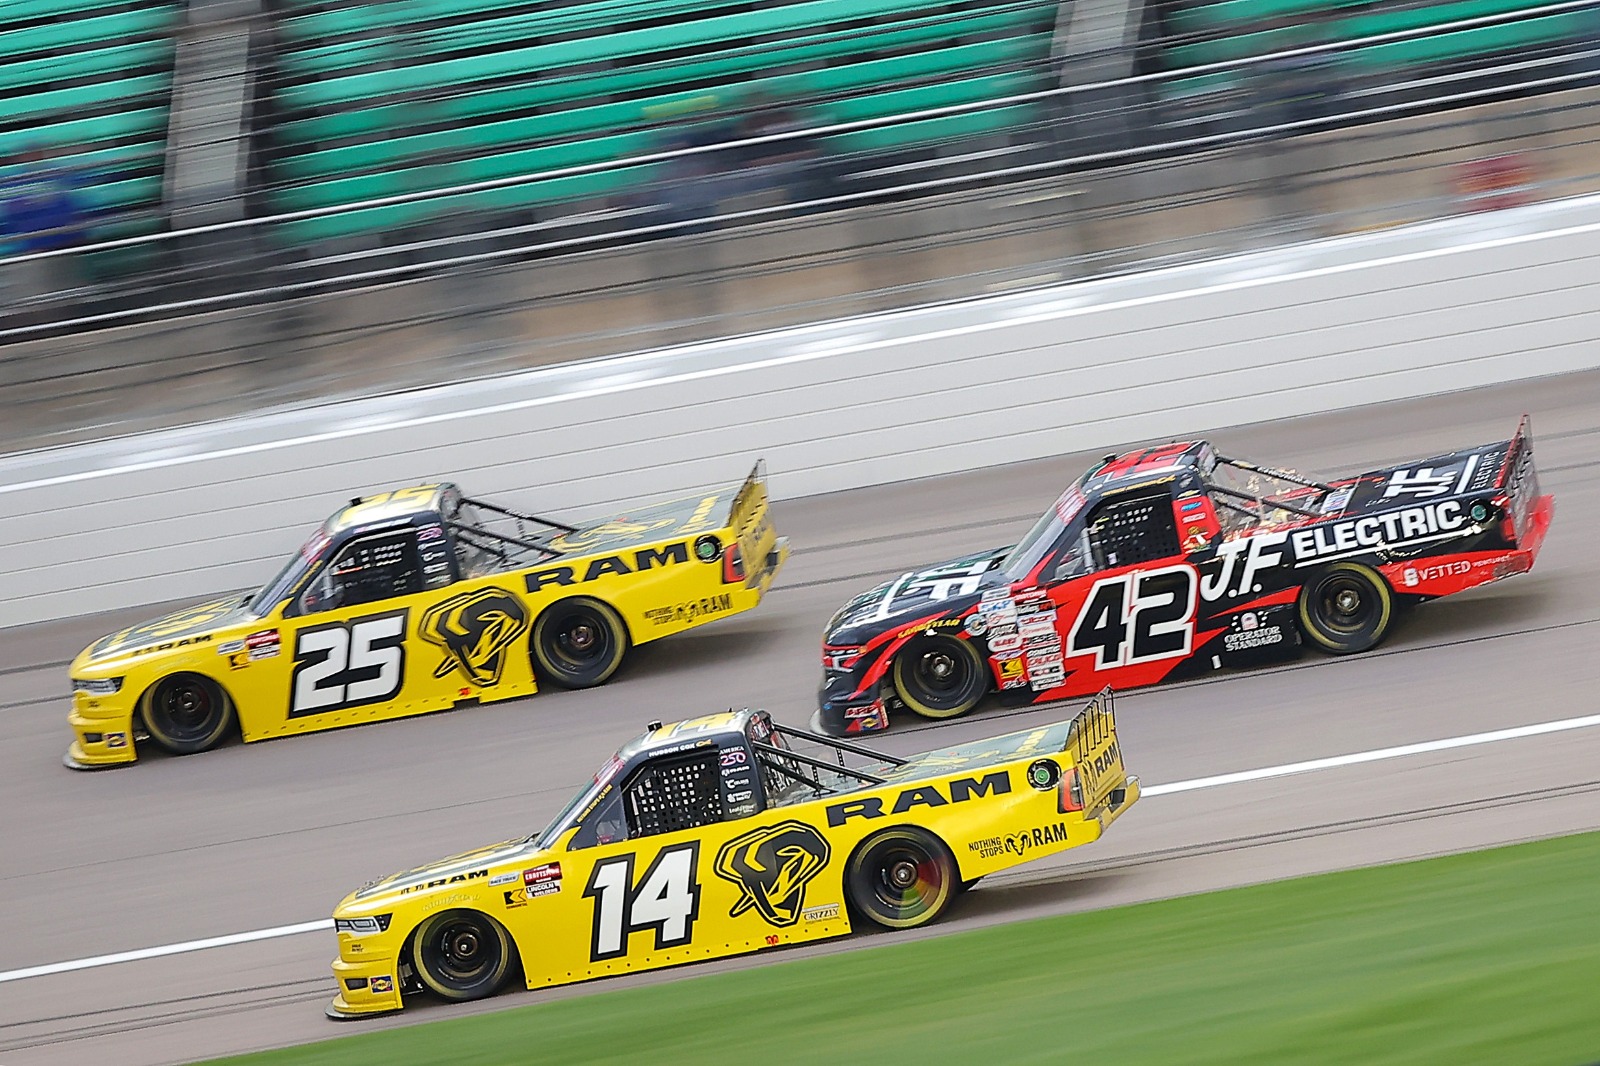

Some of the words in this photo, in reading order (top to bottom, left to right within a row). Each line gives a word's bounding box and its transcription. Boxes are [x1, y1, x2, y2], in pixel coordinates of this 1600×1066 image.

[1471, 451, 1501, 490] ELECTRIC
[1292, 501, 1466, 560] ELECTRIC
[525, 541, 689, 594] RAM
[1418, 560, 1472, 581] VETTED
[699, 592, 734, 617] RAM
[1065, 563, 1199, 672] 42
[1224, 626, 1282, 644] OPERATOR
[1225, 634, 1283, 652] STANDARD
[291, 610, 407, 717] 25
[648, 746, 680, 758] HUDSON
[679, 742, 696, 752] COX
[719, 746, 745, 756] AMERICA
[720, 752, 747, 767] 250
[1094, 740, 1120, 778] RAM
[825, 770, 1012, 829] RAM
[968, 836, 1002, 852] NOTHING
[1032, 822, 1068, 847] RAM
[980, 846, 1005, 859] STOPS
[427, 869, 489, 888] RAM
[526, 882, 555, 894] LINCOLN
[588, 843, 699, 958] 14
[803, 908, 839, 921] GRIZZLY
